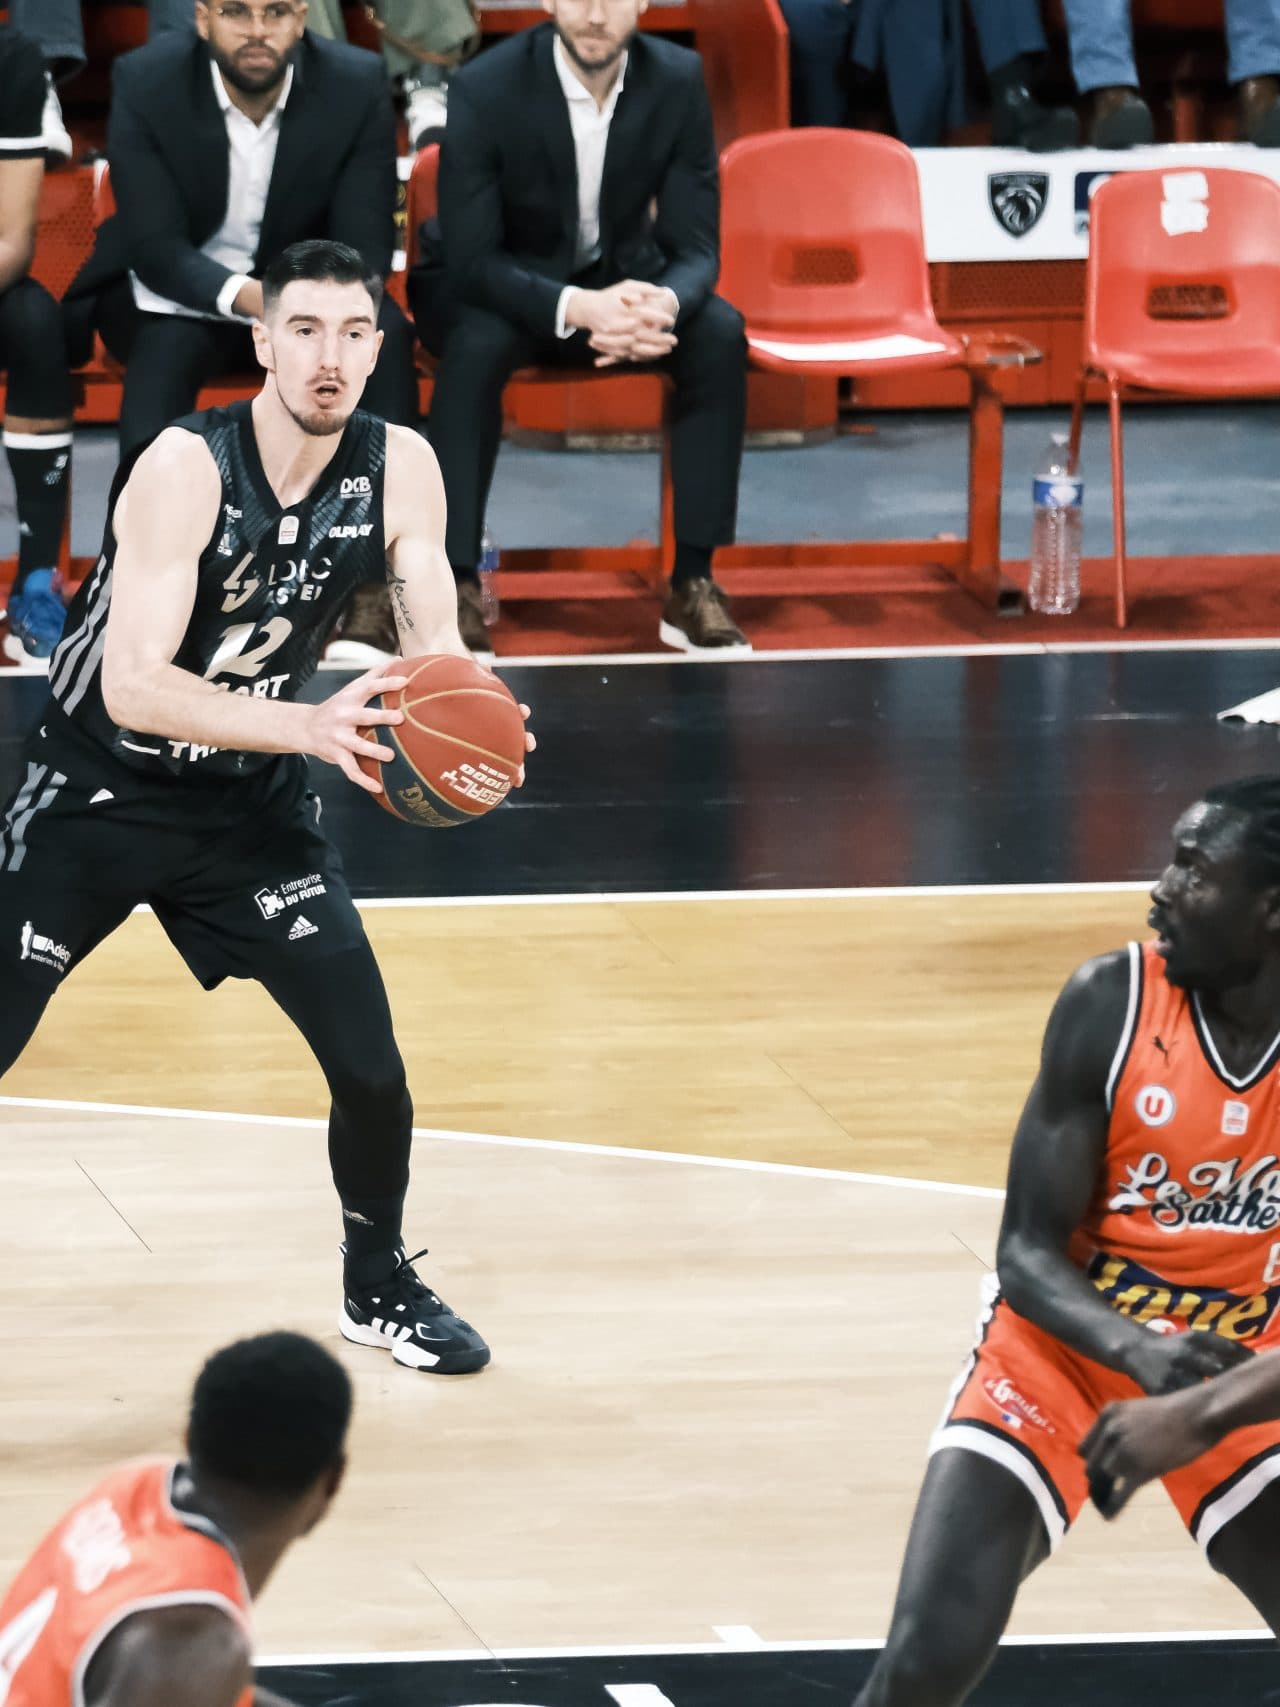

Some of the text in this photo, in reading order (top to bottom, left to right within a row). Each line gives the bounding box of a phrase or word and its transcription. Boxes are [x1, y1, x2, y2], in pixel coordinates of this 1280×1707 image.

[340, 476, 371, 493] DCB
[204, 616, 293, 681] 12
[280, 873, 322, 895] Entreprise
[285, 884, 327, 906] DU FUTUR
[288, 925, 319, 941] adidas
[1144, 1095, 1164, 1118] U
[1108, 1152, 1192, 1210] Le
[1151, 1185, 1280, 1234] Sarthe
